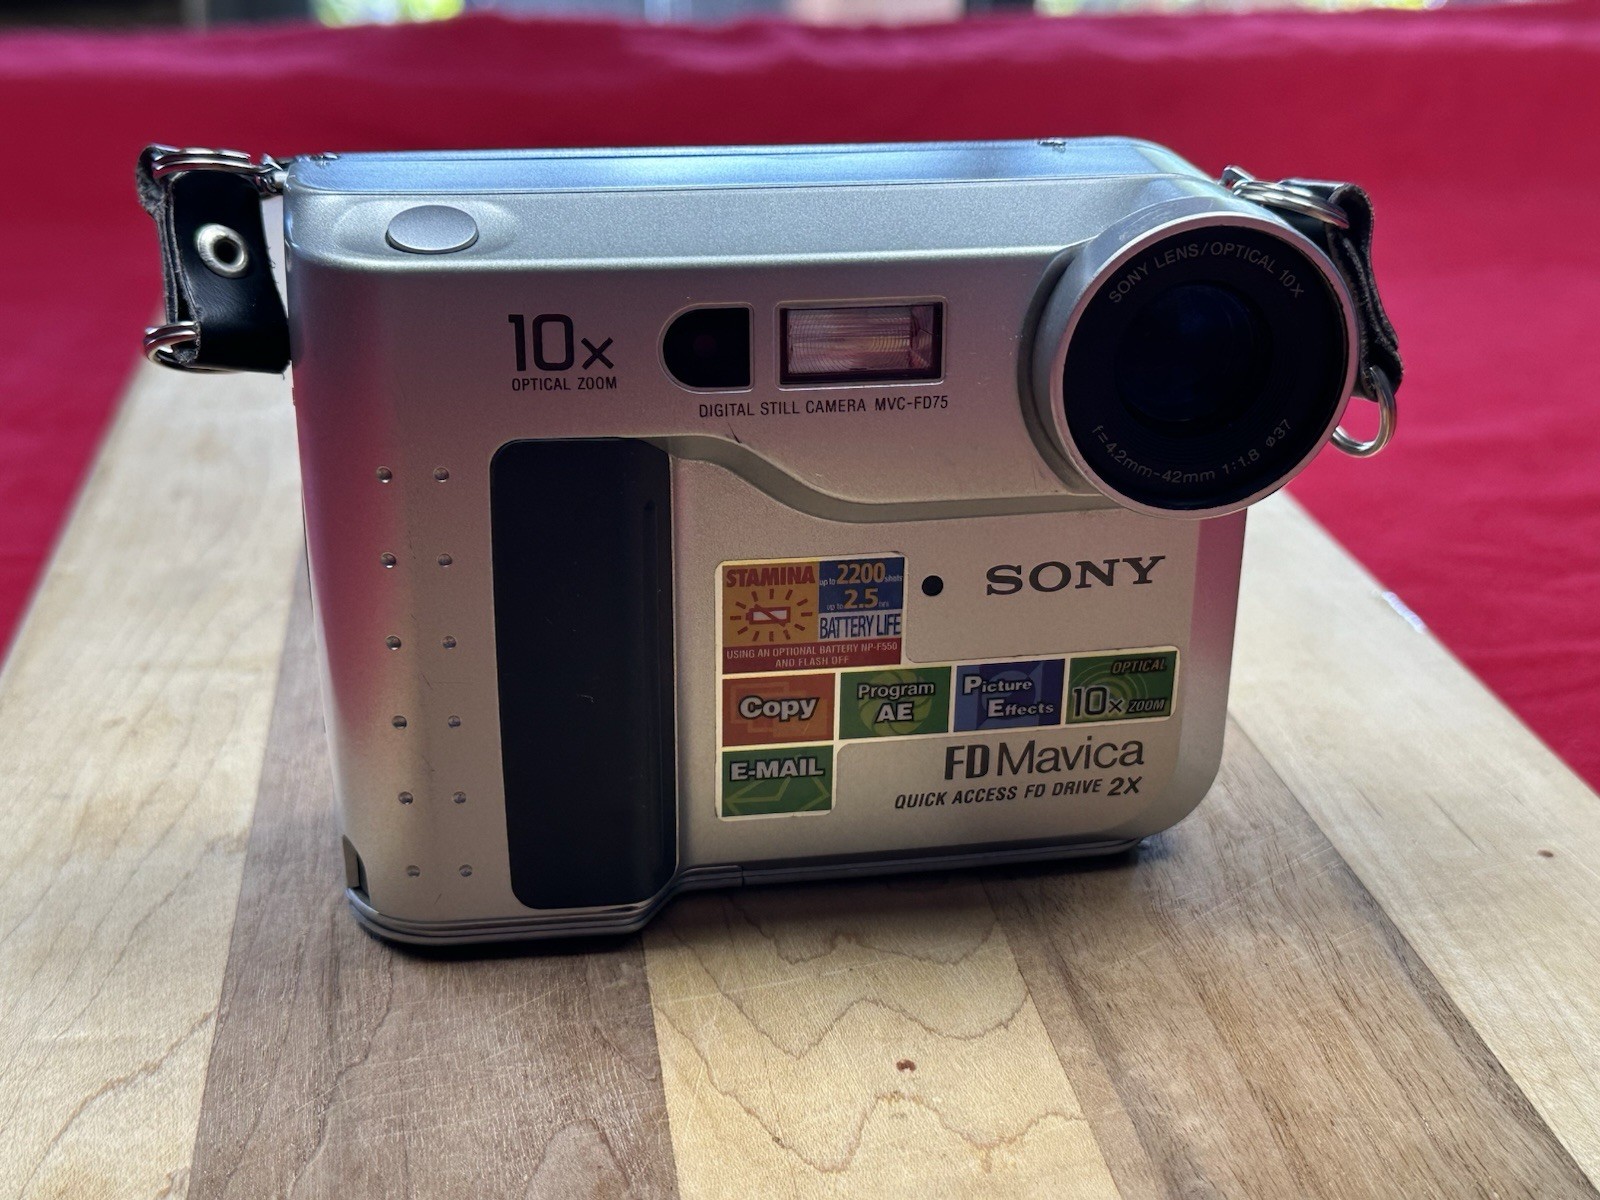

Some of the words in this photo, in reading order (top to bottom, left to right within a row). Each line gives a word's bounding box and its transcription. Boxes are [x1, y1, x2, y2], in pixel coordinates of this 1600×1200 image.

[1109, 262, 1149, 303] SONY
[1154, 241, 1275, 274] LENS/OPTICAL
[511, 377, 571, 392] OPTICAL
[577, 376, 617, 390] ZOOM
[699, 402, 755, 418] DIGITAL
[760, 401, 799, 416] STILL
[805, 398, 866, 414] CAMERA
[874, 395, 949, 412] MVC-FD75
[1222, 448, 1261, 475] 1:1.8
[726, 566, 816, 588] STAMINA
[819, 578, 828, 587] up
[829, 577, 836, 586] to
[836, 562, 886, 585] 2200
[985, 555, 1166, 596] SONY
[844, 587, 879, 610] 2.5
[820, 614, 874, 640] BATTERY
[877, 613, 901, 637] LIFE
[727, 650, 755, 660] USING
[757, 648, 770, 658] AN
[773, 645, 817, 657] OPTIONAL
[820, 643, 858, 655] BATTERY
[861, 641, 898, 652] NP-F550
[775, 660, 795, 668] AND
[798, 657, 829, 667] FLASH
[832, 655, 849, 665] OFF
[1111, 658, 1166, 675] OPTICAL
[858, 682, 935, 699] Program
[963, 675, 1033, 695] Picture
[739, 696, 819, 722] Copy
[875, 702, 914, 724] AE
[987, 699, 1055, 719] Effects
[1127, 699, 1166, 714] ZOOM
[730, 757, 825, 782] E-MAIL
[894, 792, 947, 809] QUICK
[951, 785, 1018, 805] ACCESS
[1023, 783, 1046, 799] FD
[1051, 778, 1104, 796] DRIVE
[1106, 775, 1143, 797] 2X
